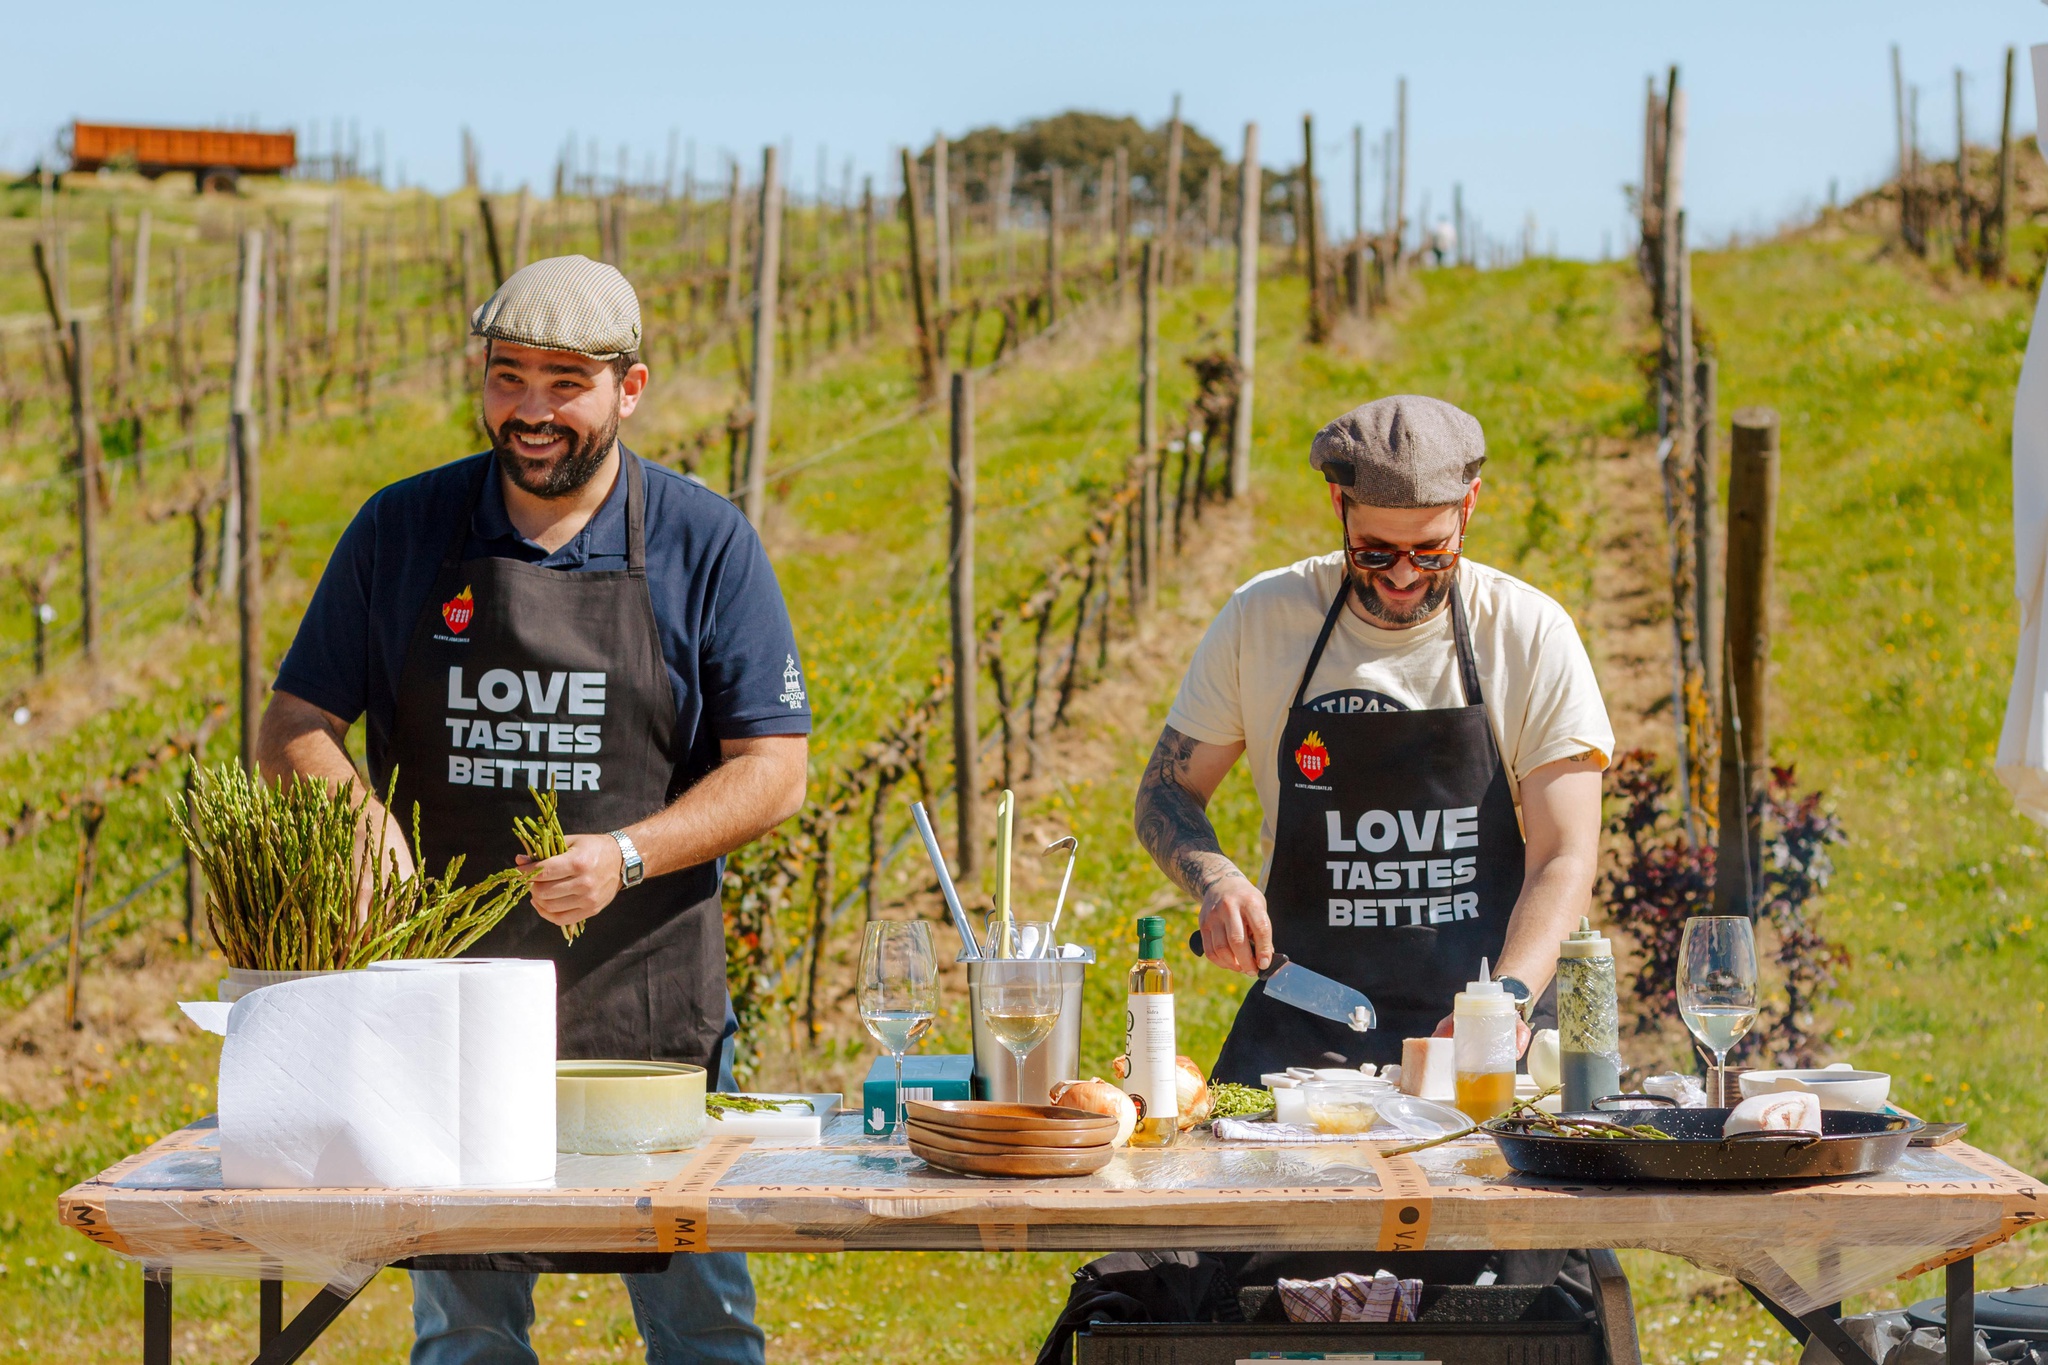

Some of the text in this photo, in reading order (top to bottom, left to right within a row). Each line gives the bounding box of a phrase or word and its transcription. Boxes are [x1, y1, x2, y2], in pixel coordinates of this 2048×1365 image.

[447, 666, 607, 716] LOVE
[445, 717, 601, 754] TASTES
[448, 755, 601, 791] BETTER
[1325, 806, 1479, 853] LOVE
[1326, 856, 1477, 890] TASTES
[1328, 891, 1479, 927] BETTER
